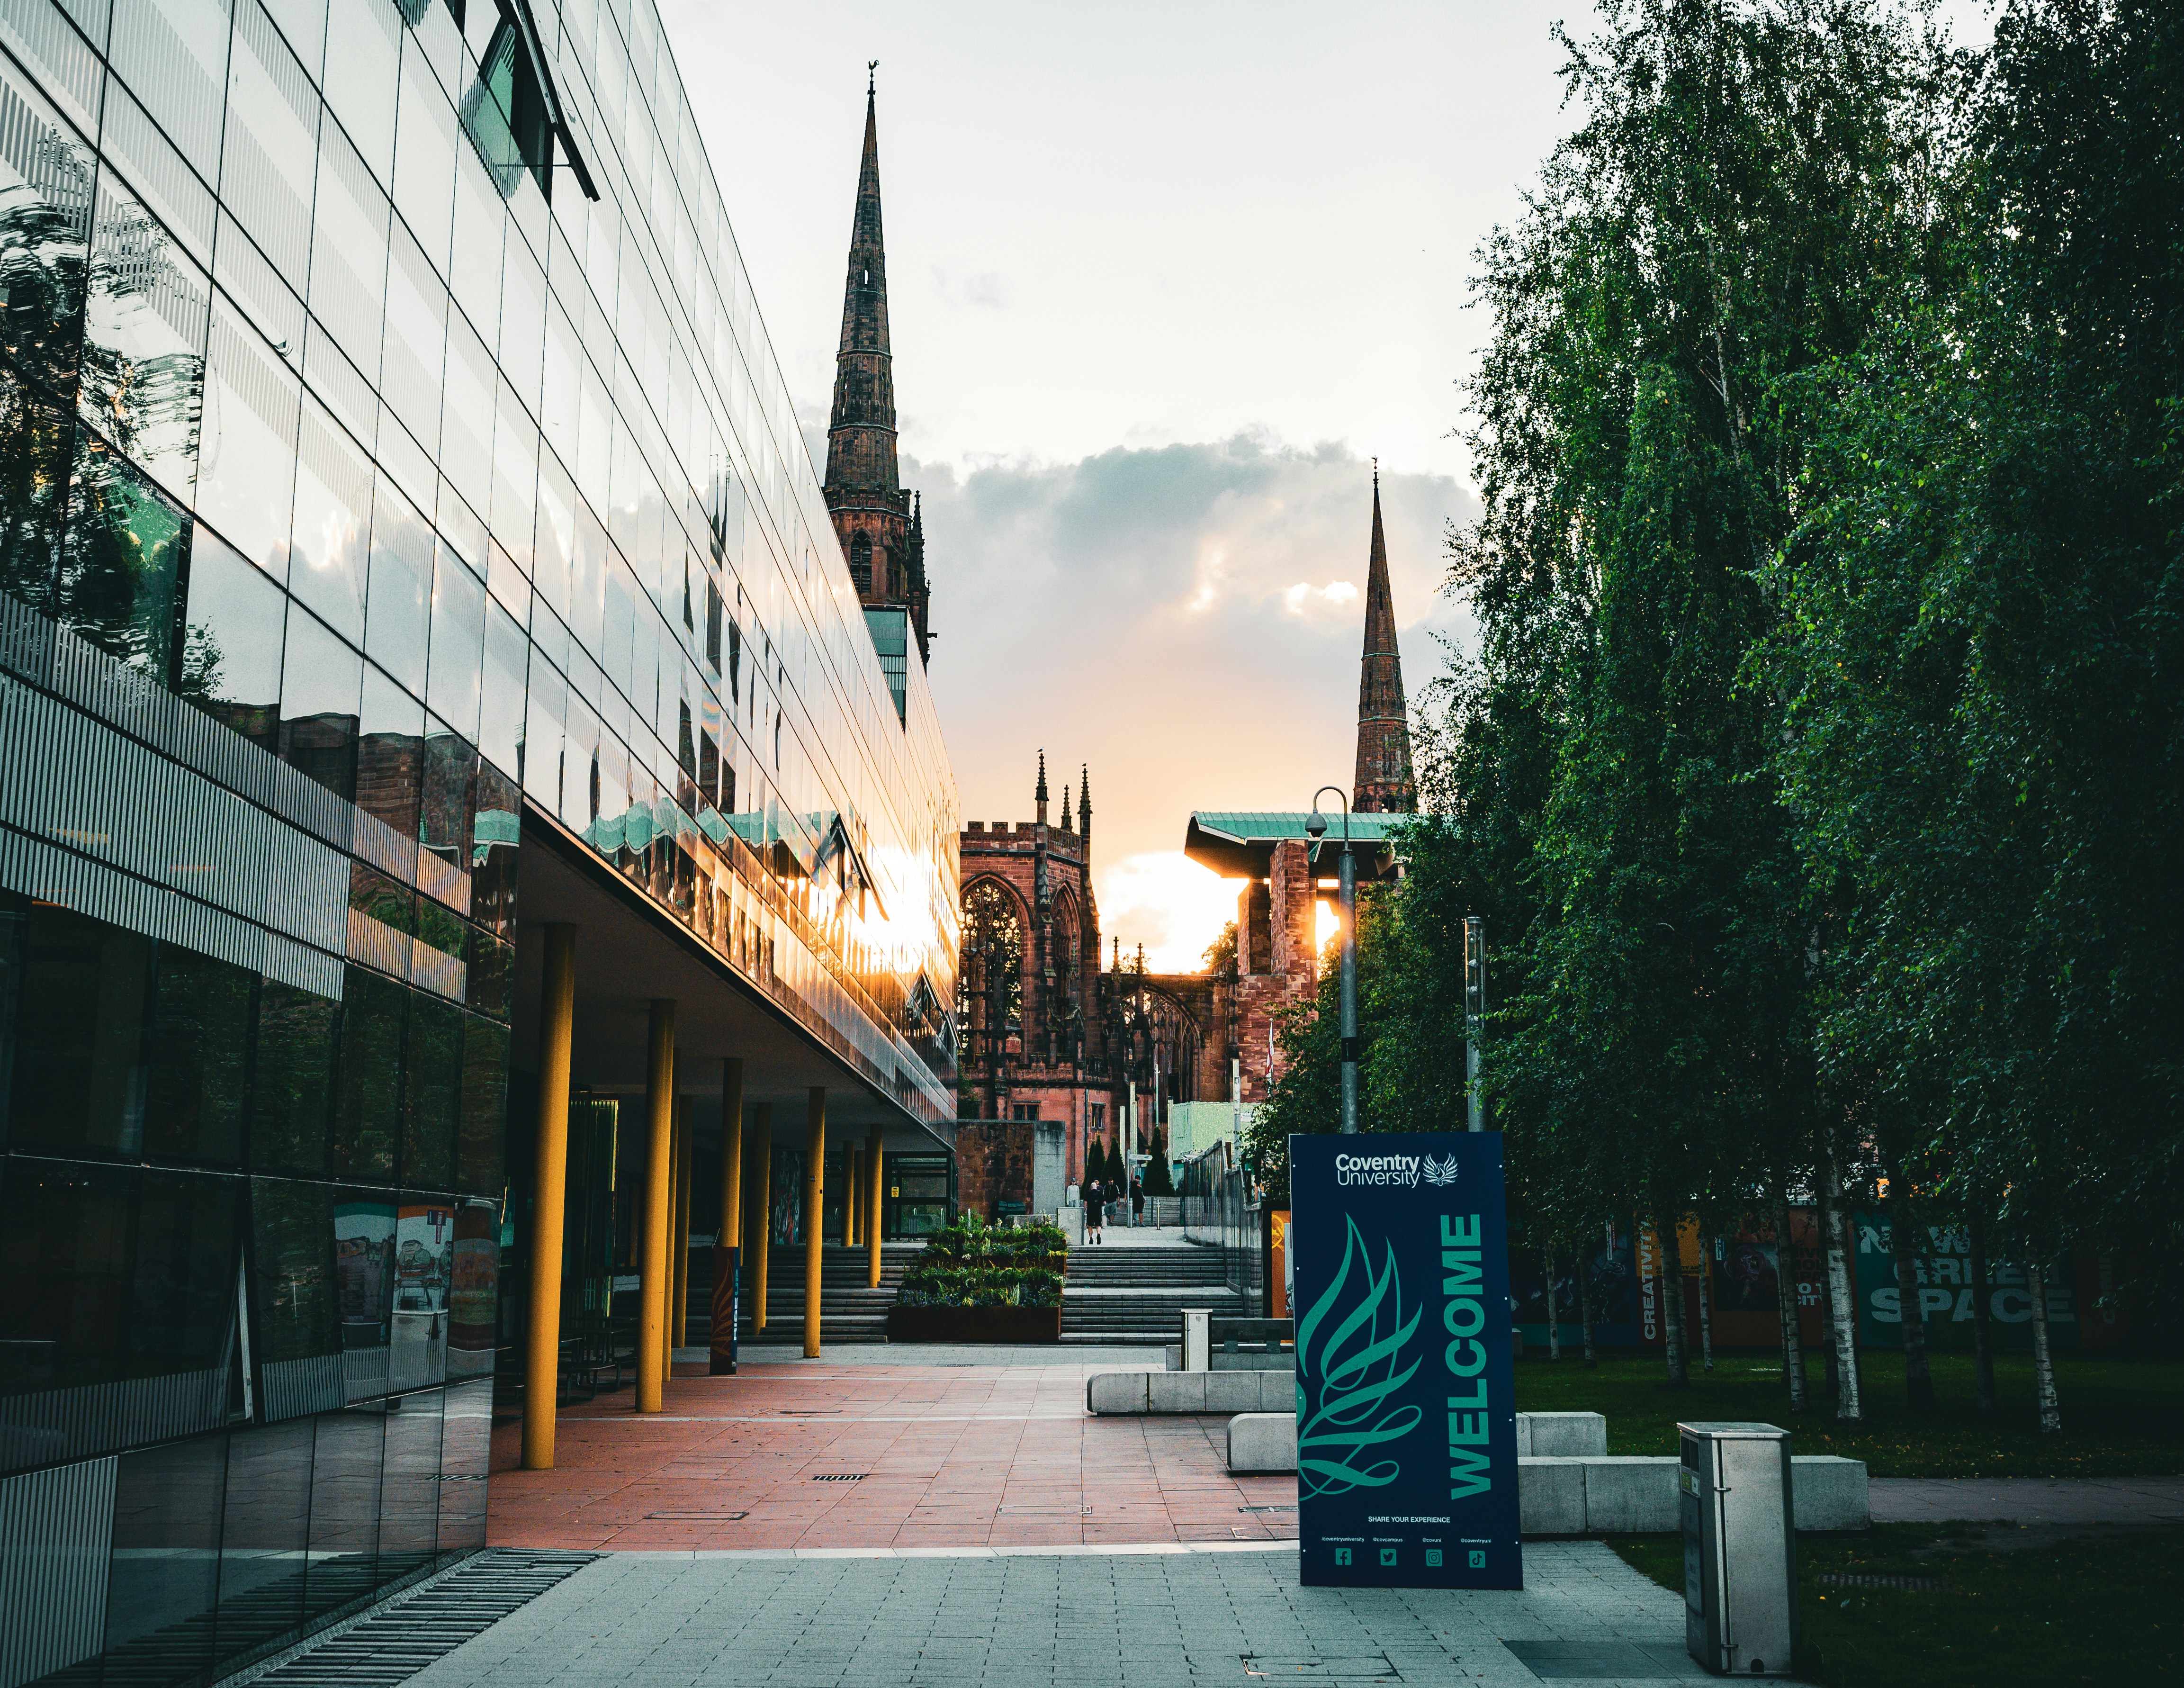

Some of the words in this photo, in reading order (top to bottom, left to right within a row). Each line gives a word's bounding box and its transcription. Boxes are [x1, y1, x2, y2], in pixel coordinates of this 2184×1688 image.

[1336, 1154, 1420, 1175] Coventry
[1337, 1169, 1420, 1189] University
[1860, 1225, 1970, 1254] NW
[735, 1269, 738, 1296] UP
[1641, 1221, 1656, 1340] CREATIVITY
[1870, 1287, 2075, 1323] SPACE
[1440, 1214, 1492, 1500] WELCOME
